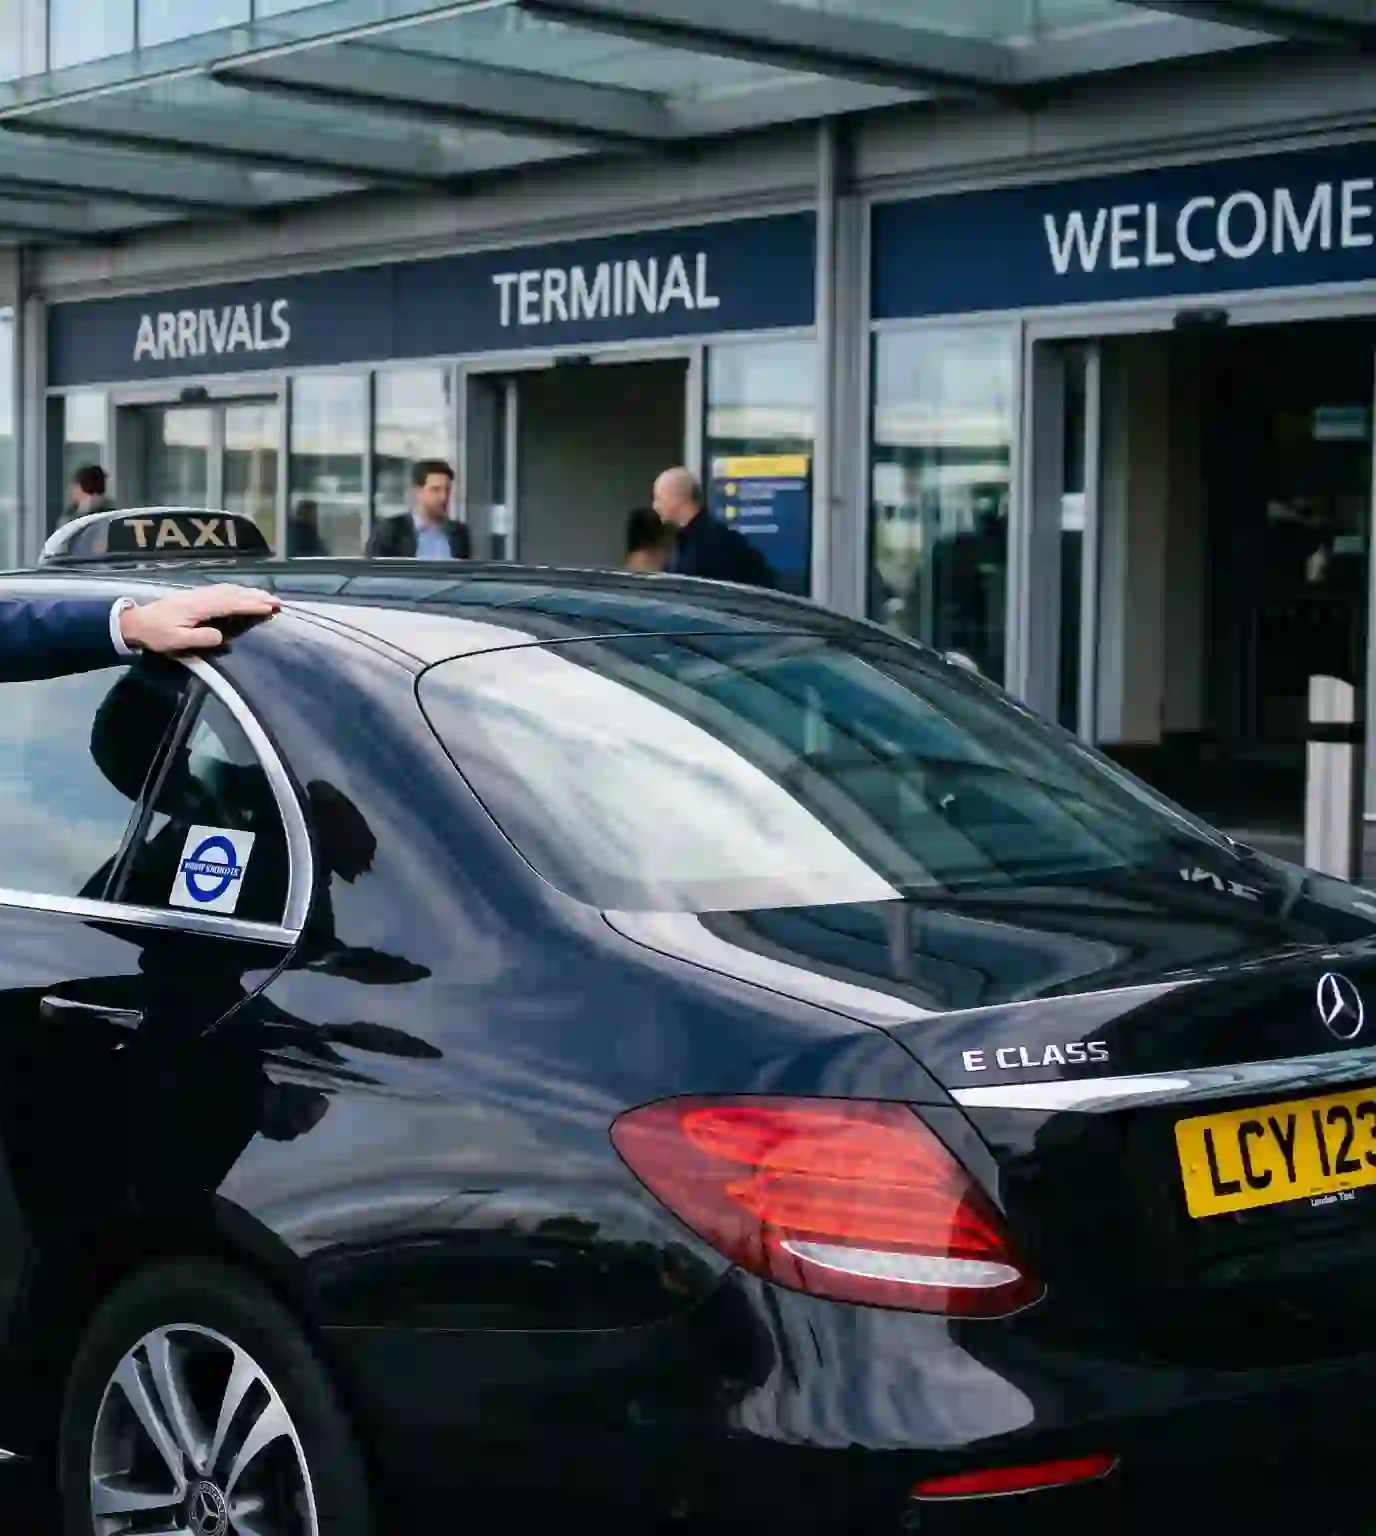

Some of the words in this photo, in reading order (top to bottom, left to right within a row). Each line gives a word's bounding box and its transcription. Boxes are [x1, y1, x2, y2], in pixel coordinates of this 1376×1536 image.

[1043, 178, 1374, 274] WELCOME
[133, 298, 291, 362] ARRIVALS
[491, 252, 721, 327] TERMINAL
[123, 517, 238, 548] TAXI
[962, 1048, 987, 1072] E
[995, 1040, 1110, 1069] CLASS
[1203, 1113, 1297, 1197] LCY
